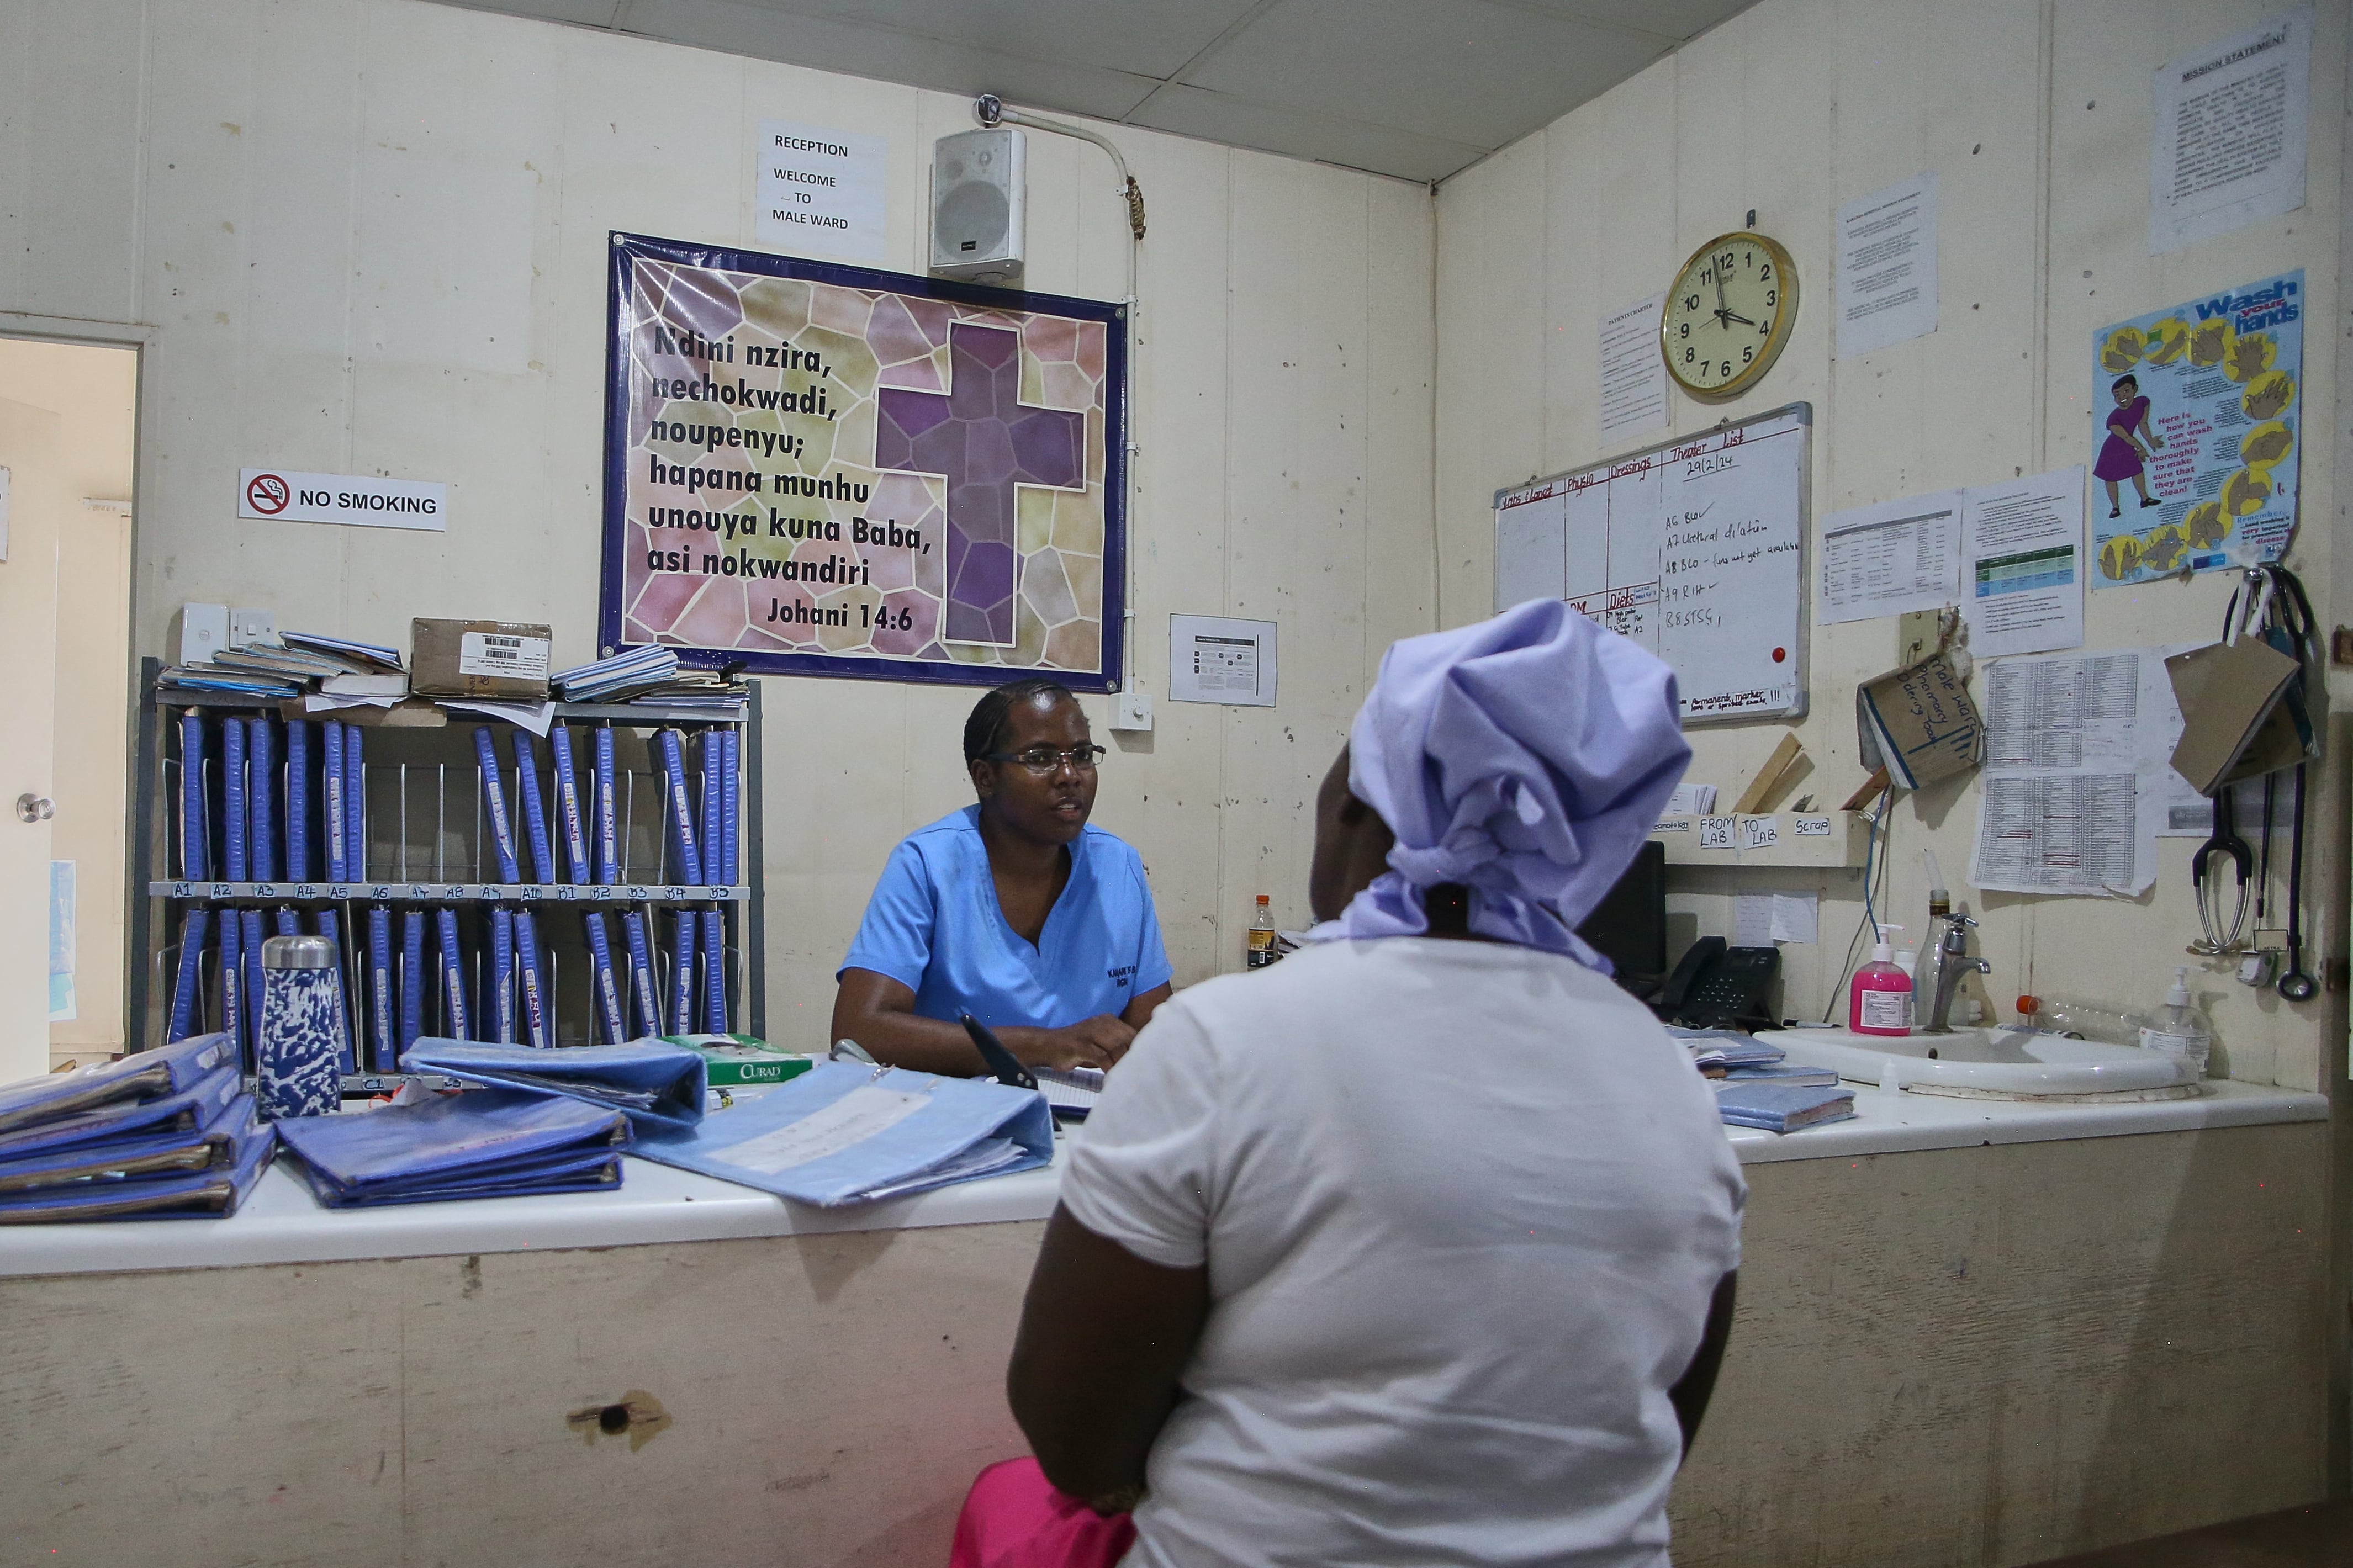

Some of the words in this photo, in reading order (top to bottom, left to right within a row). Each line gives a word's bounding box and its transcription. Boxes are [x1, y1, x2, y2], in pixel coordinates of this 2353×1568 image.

[2181, 59, 2222, 81] MISSION
[2225, 34, 2286, 64] STATEMENT
[775, 135, 848, 157] RECEPTION
[774, 168, 836, 187] WELCOME
[794, 192, 812, 204] TO
[773, 209, 806, 224] MALE
[810, 214, 848, 229] WARD
[1720, 252, 1734, 271] 12
[1745, 251, 1752, 268] 1
[1700, 268, 1712, 286] 11
[1760, 264, 1770, 282] 2
[1685, 294, 1700, 312] 10
[1767, 290, 1776, 306] 3
[2195, 280, 2297, 321] Wash
[2240, 298, 2285, 318] your
[2235, 301, 2299, 336] hands
[1680, 323, 1690, 339] 9
[1759, 320, 1770, 336] 4
[654, 326, 734, 363] Ndini
[745, 341, 832, 378] nzira,
[1685, 347, 1695, 363] 8
[1743, 346, 1752, 363] 5
[1700, 360, 1710, 377] 7
[1721, 360, 1731, 377] 6
[652, 373, 837, 421] nechokwadi,
[2158, 415, 2180, 425] Here
[2166, 422, 2185, 432] how
[2188, 418, 2206, 428] you
[651, 420, 804, 460] noupenyu;
[2167, 433, 2184, 441] can
[2187, 425, 2213, 436] wash
[1670, 441, 1707, 462] Theater
[1723, 428, 1744, 448] List
[2170, 438, 2198, 449] hands
[2149, 447, 2199, 463] thoroughly
[2167, 458, 2192, 468] make
[1610, 456, 1651, 482] Dressings
[2153, 471, 2173, 480] sure
[2176, 466, 2195, 475] that
[650, 454, 762, 494] hapana
[774, 473, 869, 504] munhu
[1567, 472, 1594, 497] Physio
[2155, 480, 2175, 489] they
[2159, 485, 2187, 497] clean!
[300, 490, 331, 507] NO
[337, 492, 437, 515] SMOKING
[649, 506, 757, 540] unouya
[769, 507, 840, 542] kuna
[852, 516, 931, 555] Baba,
[1665, 515, 1678, 531] A6
[1667, 533, 1680, 550] A7
[647, 544, 690, 573] asi
[702, 548, 869, 586] nokwandiri
[1665, 560, 1677, 575] A8
[1609, 587, 1635, 610] Diets
[767, 597, 848, 627] Johani
[860, 603, 913, 631] 14:6
[1929, 658, 1954, 691] Male
[1735, 690, 1764, 701] marker
[1700, 814, 1737, 830] FROM
[1742, 819, 1758, 833] TO
[1796, 820, 1828, 834] Scrap
[1700, 833, 1727, 847] LAB
[1752, 829, 1778, 845] LAB
[175, 885, 191, 896] A1
[213, 886, 232, 896] A2
[257, 886, 274, 897] A3
[297, 886, 316, 898] A4
[331, 886, 348, 897] A5
[372, 887, 388, 898] A6
[446, 887, 464, 897] A8
[521, 887, 542, 899] A10
[558, 887, 575, 899] B1
[593, 887, 610, 899] B2
[628, 887, 647, 898] B3
[665, 887, 686, 899] B4
[710, 886, 729, 898] B5
[740, 1063, 780, 1079] CURAD
[364, 1079, 385, 1089] C1
